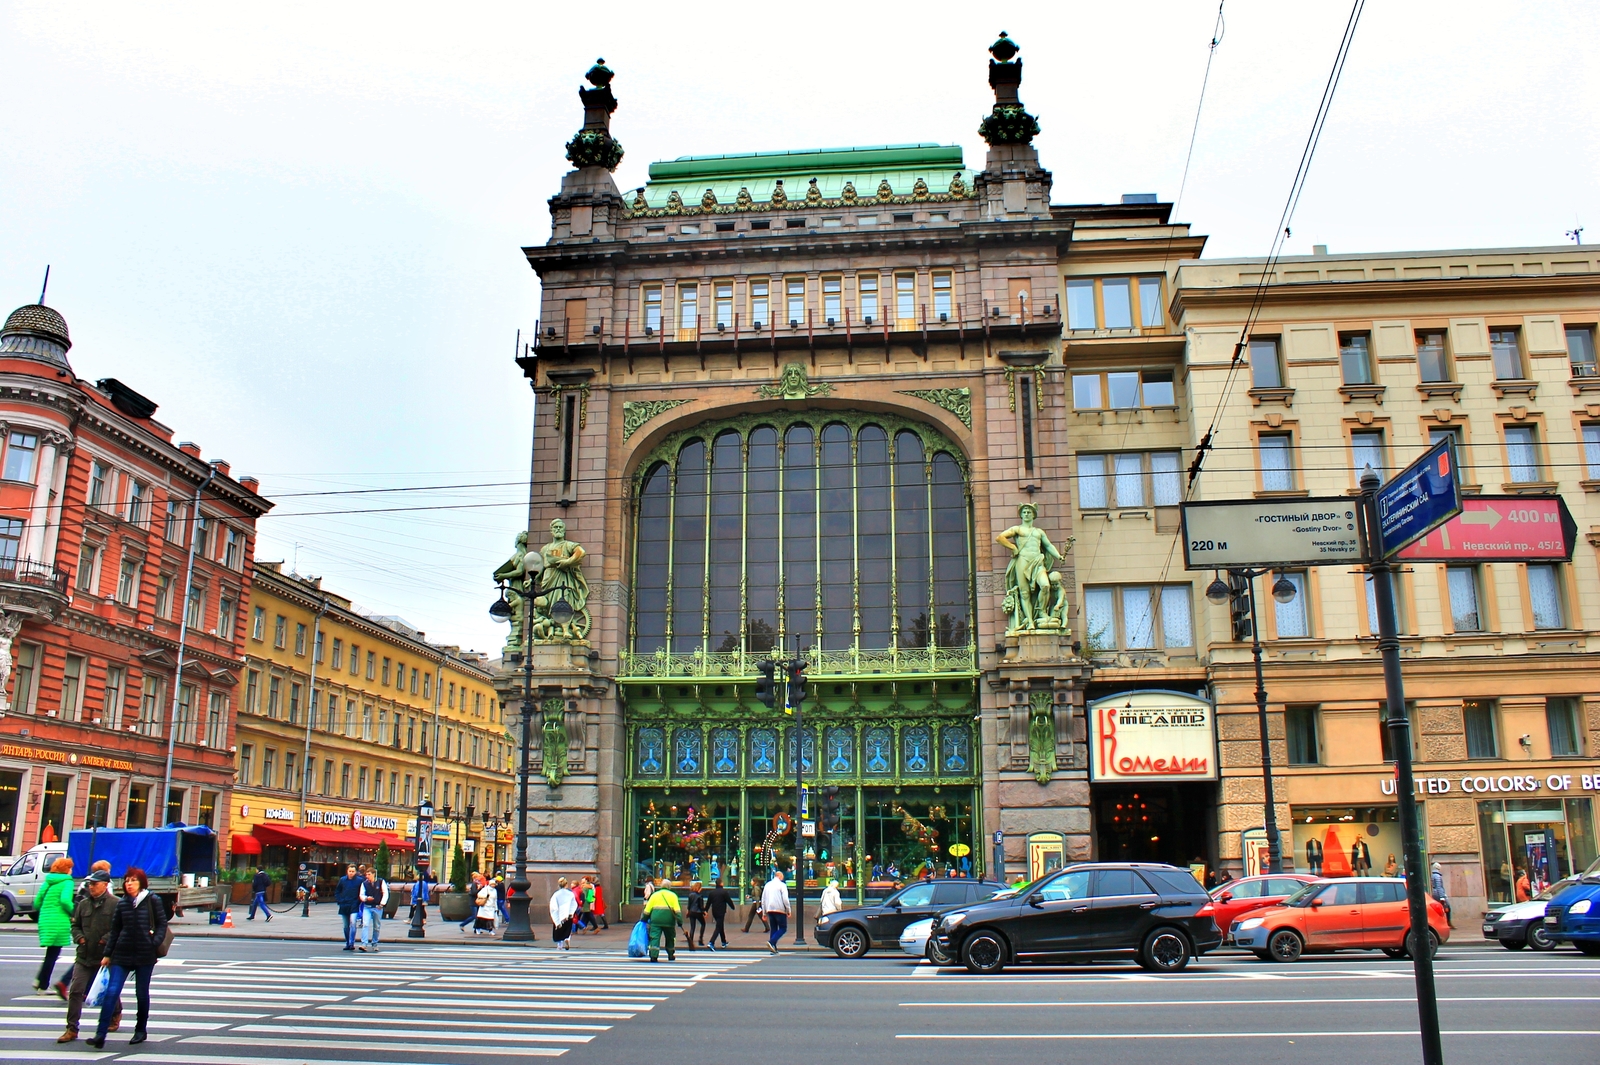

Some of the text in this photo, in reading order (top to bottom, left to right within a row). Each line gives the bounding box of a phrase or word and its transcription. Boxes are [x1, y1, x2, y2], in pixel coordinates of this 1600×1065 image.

[1381, 491, 1429, 529] ЕКАТЕРИНИНСКИЙ САД
[1507, 510, 1558, 523] 400 м
[1254, 512, 1341, 523] «ГОСТИНЫЙ ДВОР»
[1292, 526, 1321, 534] «Gostiny
[1191, 540, 1228, 551] 220 м
[1462, 541, 1562, 551] Невский пр., 45/2
[1119, 715, 1205, 725] ТЕАТР
[1098, 708, 1208, 776] Комедии
[1, 744, 66, 762] ЯНТАРЬ РОССИИ
[81, 755, 104, 766] AMBER
[113, 760, 133, 770] RUSSIA
[1380, 777, 1450, 795] UTED
[1461, 775, 1536, 793] COLORS
[1546, 774, 1572, 791] OF
[265, 808, 294, 821] КОФЕЙНЯ
[306, 809, 350, 826] THE COFFEE
[363, 815, 398, 830] BREAKFAST
